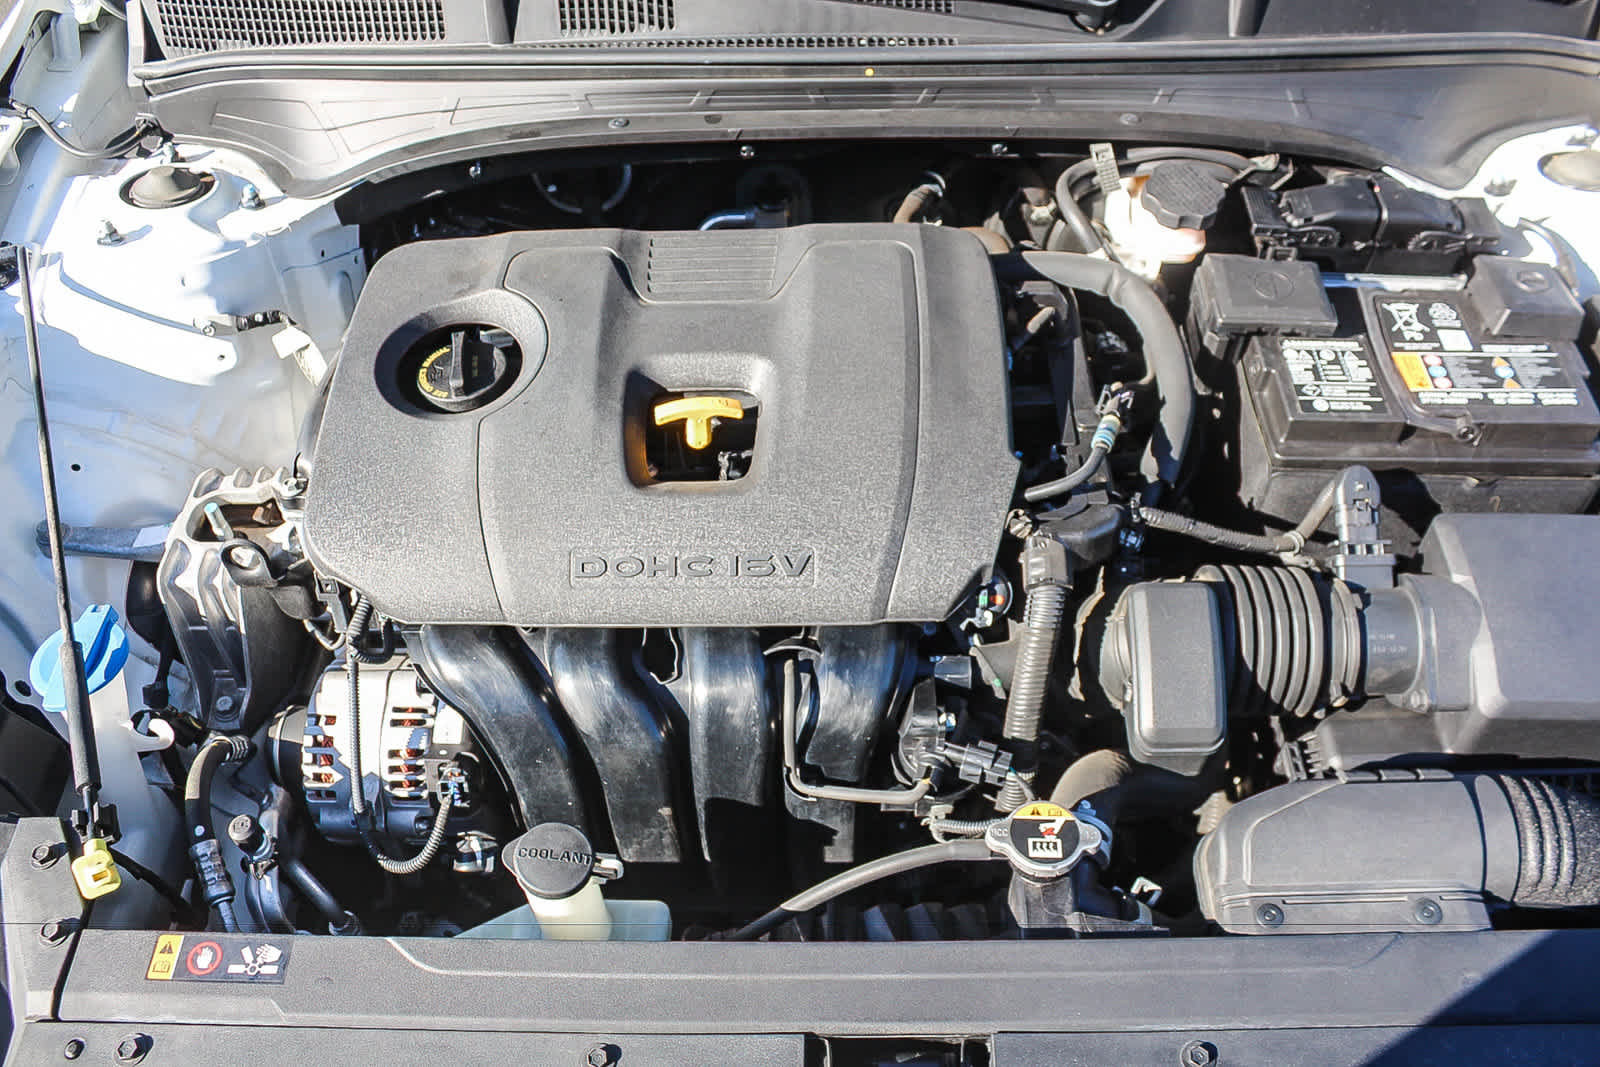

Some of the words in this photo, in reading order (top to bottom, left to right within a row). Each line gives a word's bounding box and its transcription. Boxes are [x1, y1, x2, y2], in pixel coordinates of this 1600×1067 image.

[574, 554, 713, 577] DOHC
[728, 553, 812, 577] 16V
[518, 848, 592, 866] COOLANT
